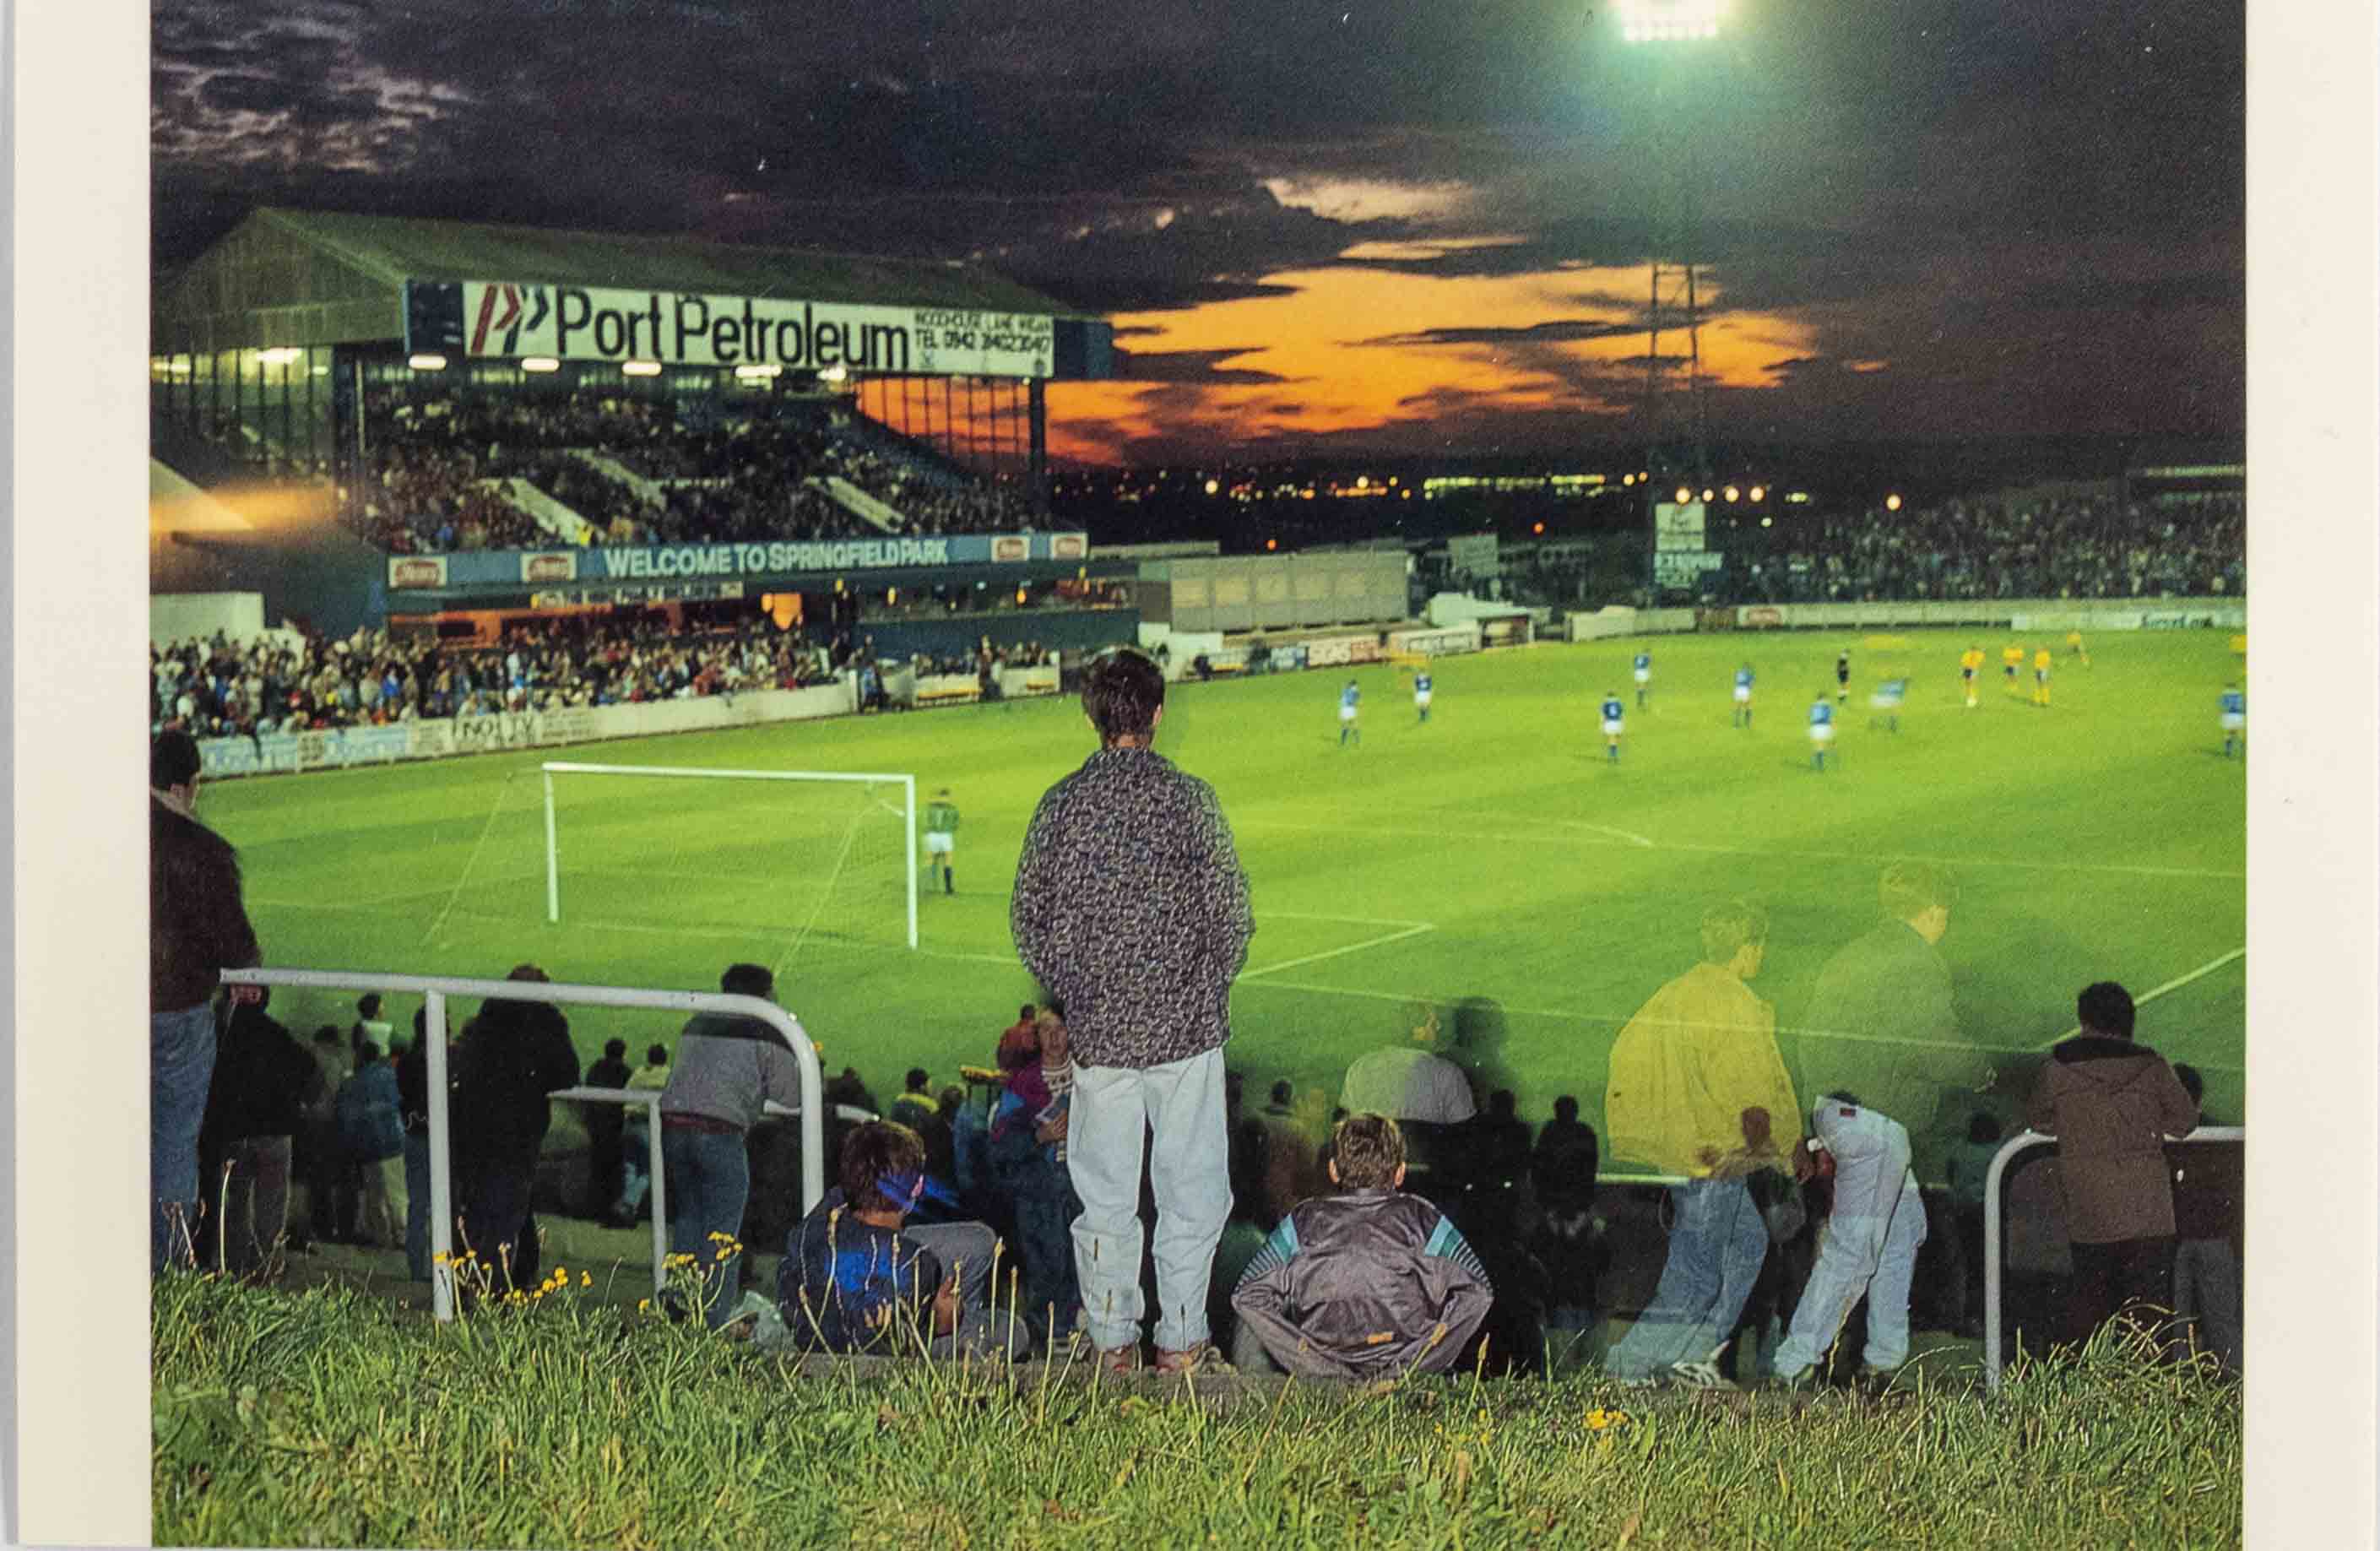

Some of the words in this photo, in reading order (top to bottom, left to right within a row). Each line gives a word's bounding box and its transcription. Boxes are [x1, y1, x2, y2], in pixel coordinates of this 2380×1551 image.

[556, 288, 663, 361] Port
[675, 294, 909, 369] Petroleum
[604, 546, 732, 578] WELCOME
[734, 543, 767, 572] TO
[768, 540, 899, 572] SPRINGFIELD
[899, 537, 948, 567] PARK
